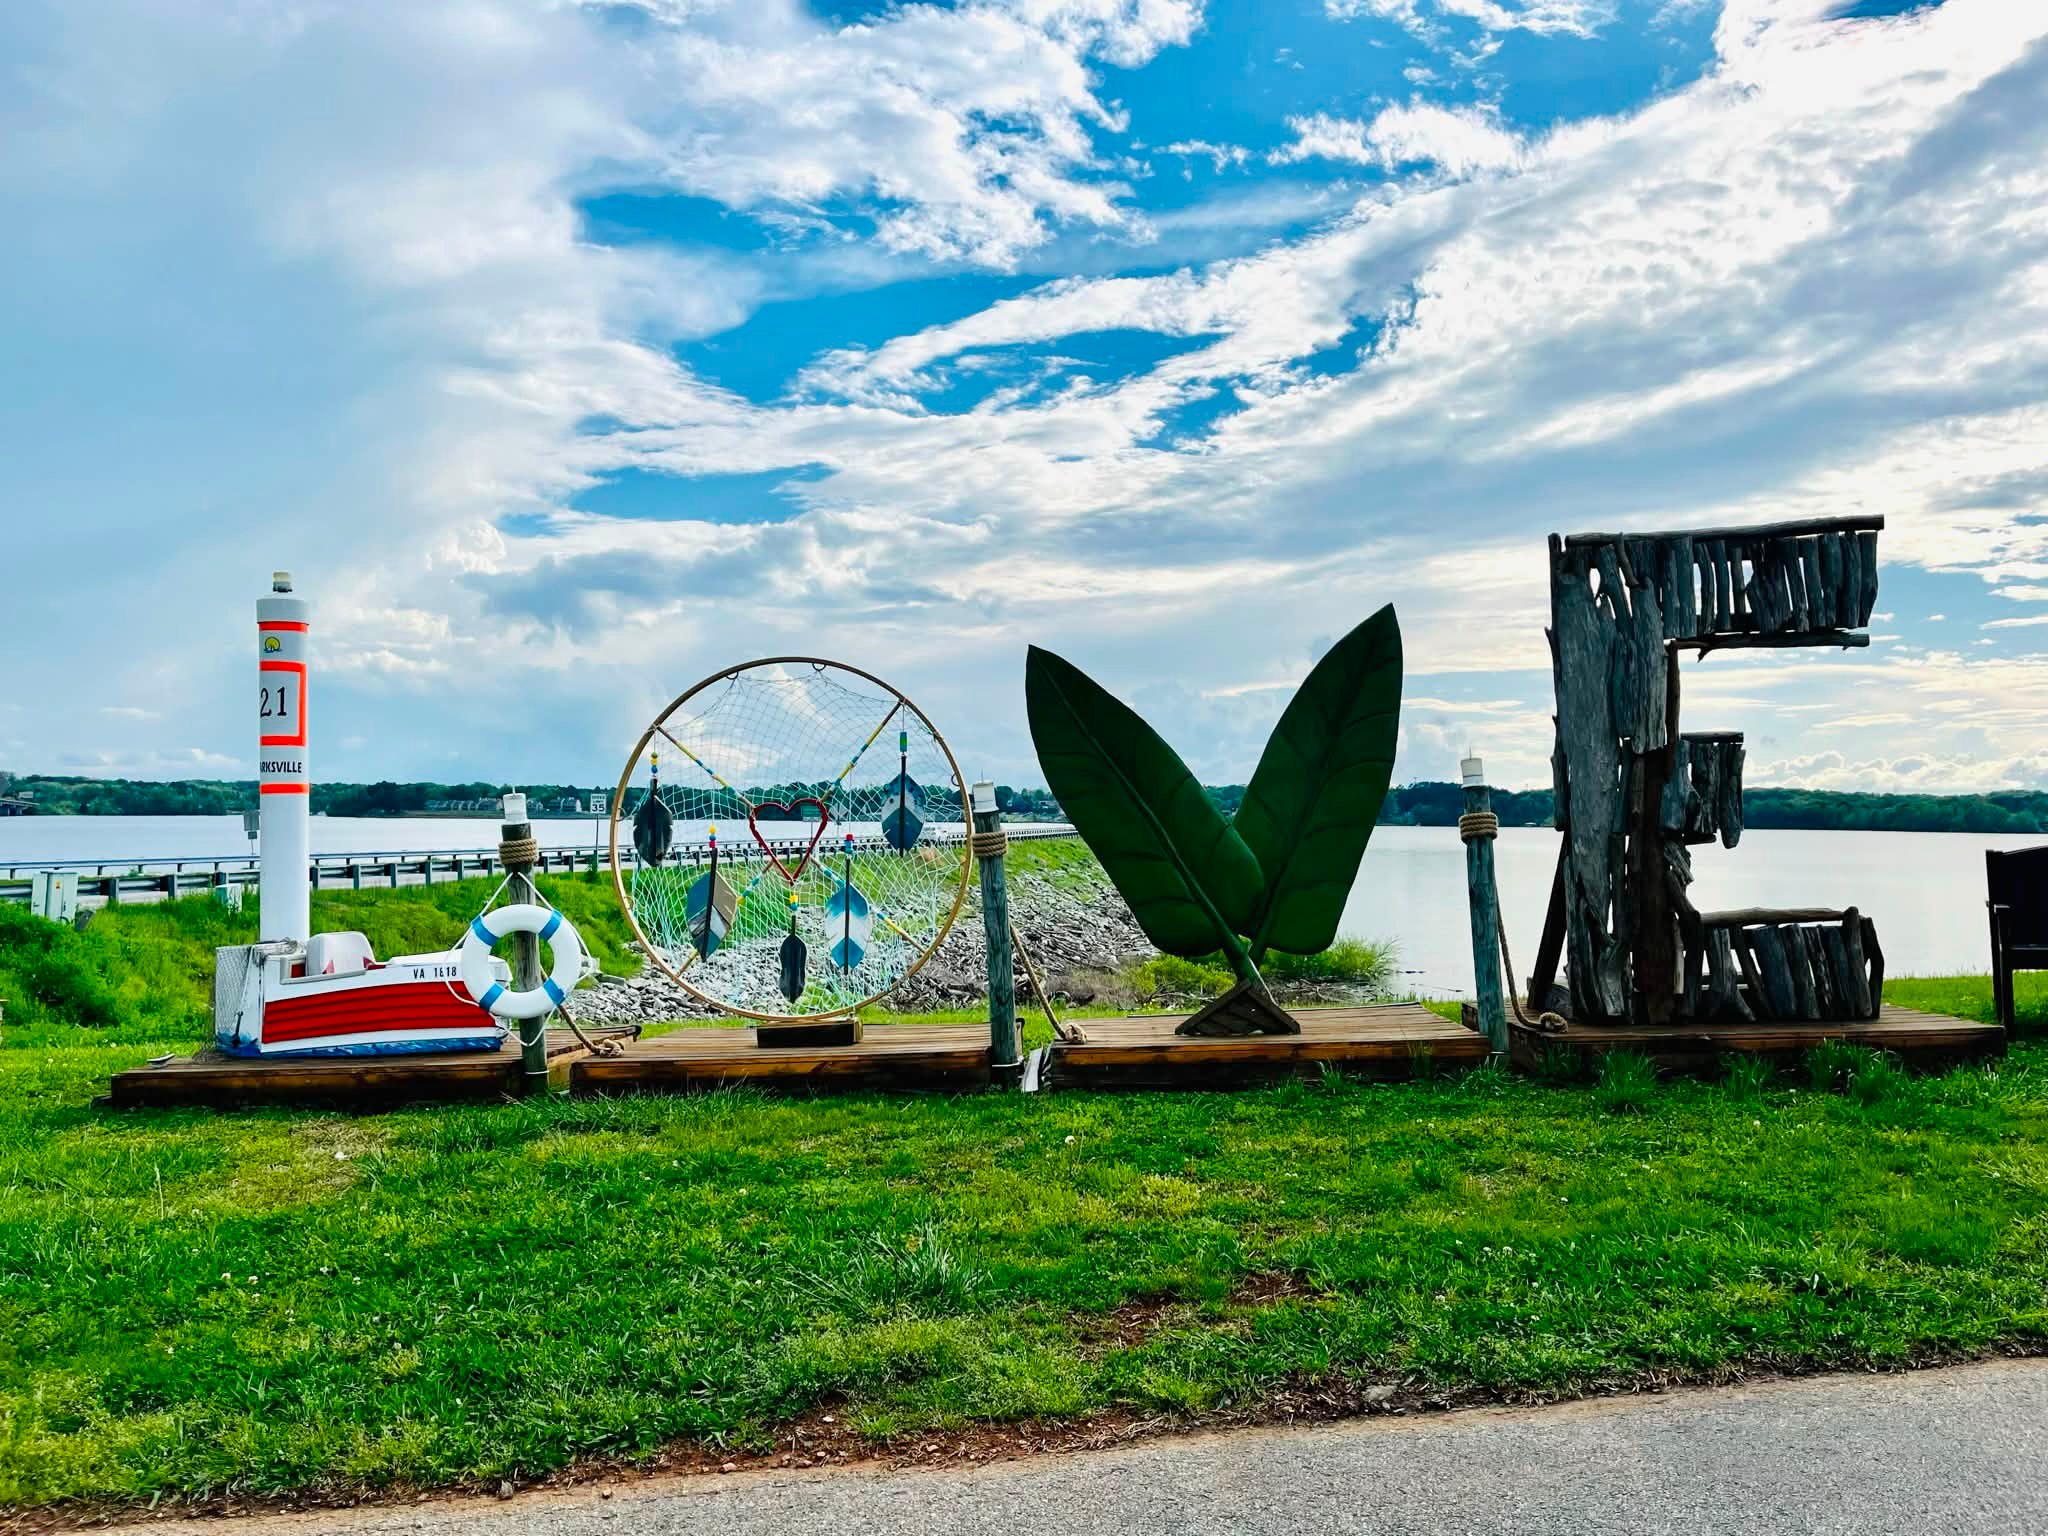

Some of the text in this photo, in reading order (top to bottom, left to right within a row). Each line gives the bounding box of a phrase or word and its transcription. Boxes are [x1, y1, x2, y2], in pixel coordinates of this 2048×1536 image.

[260, 686, 287, 718] 21
[260, 761, 302, 773] RKSVILLE
[592, 804, 605, 812] 35
[413, 968, 425, 979] VA
